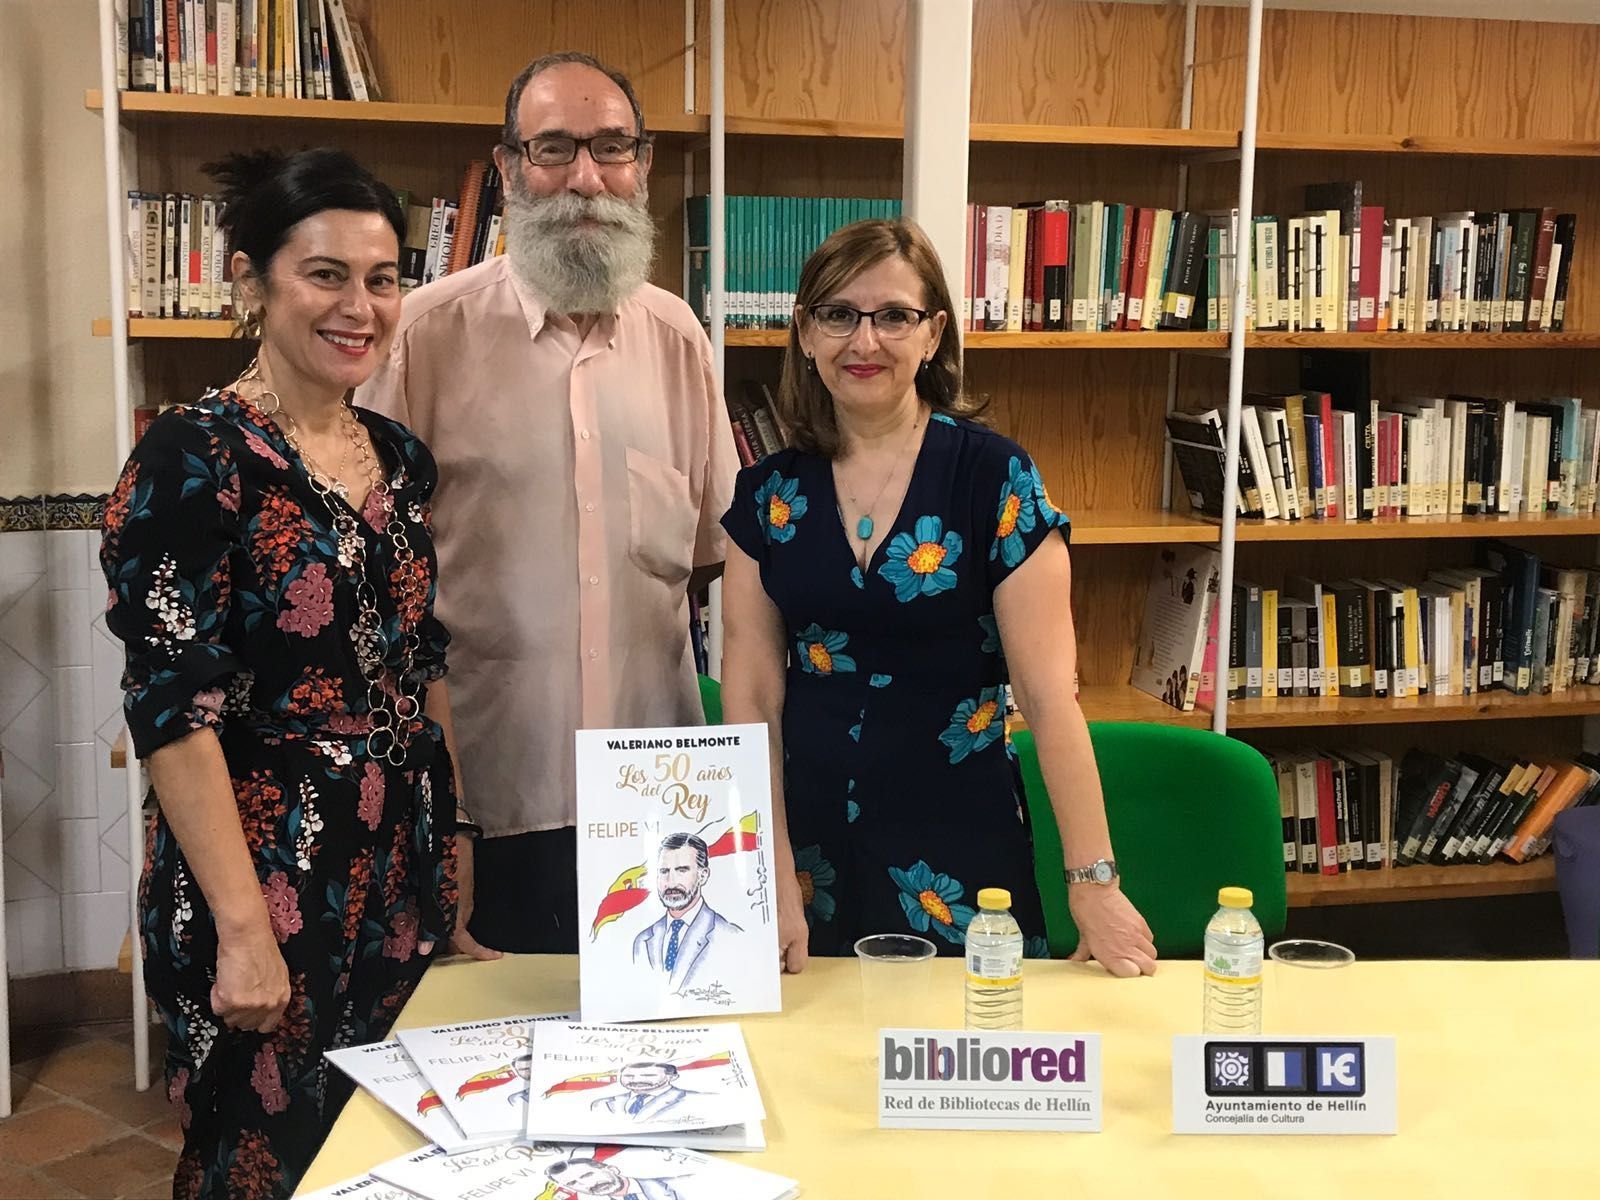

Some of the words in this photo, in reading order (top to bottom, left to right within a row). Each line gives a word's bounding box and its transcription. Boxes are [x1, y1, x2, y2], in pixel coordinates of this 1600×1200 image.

[430, 210, 442, 249] GRECIA
[1263, 226, 1273, 244] PREGO
[145, 225, 159, 267] ITALIA
[1264, 245, 1274, 269] VICTORIA
[1363, 422, 1372, 449] CEUTA
[606, 739, 673, 750] VALERIANO
[676, 736, 741, 748] BELMONTE
[615, 763, 648, 792] Los
[653, 753, 691, 782] 50
[696, 765, 735, 782] años
[641, 783, 662, 797] del
[662, 782, 712, 823] Rey
[588, 821, 639, 839] FELIPE
[431, 1022, 501, 1034] VALERIANO
[504, 1015, 570, 1025] BELMONTE
[487, 1025, 525, 1039] 50
[568, 1025, 638, 1033] VALERIANO
[429, 1054, 485, 1065] FELIPE
[490, 1051, 509, 1060] VI
[544, 1053, 600, 1063] FELIPE
[884, 1036, 1087, 1083] bibliored
[884, 1095, 913, 1110] Red
[918, 1096, 935, 1110] de
[939, 1096, 1020, 1111] Bibliotecas
[1024, 1096, 1042, 1111] de
[1046, 1097, 1091, 1112] Hellín
[1205, 1100, 1302, 1113] Ayuntamiento
[1306, 1100, 1323, 1111] de
[1327, 1100, 1367, 1111] Hellín
[1205, 1113, 1254, 1125] Concejalía
[1257, 1113, 1269, 1123] de
[1271, 1113, 1305, 1123] Cultura
[512, 1167, 537, 1178] VI
